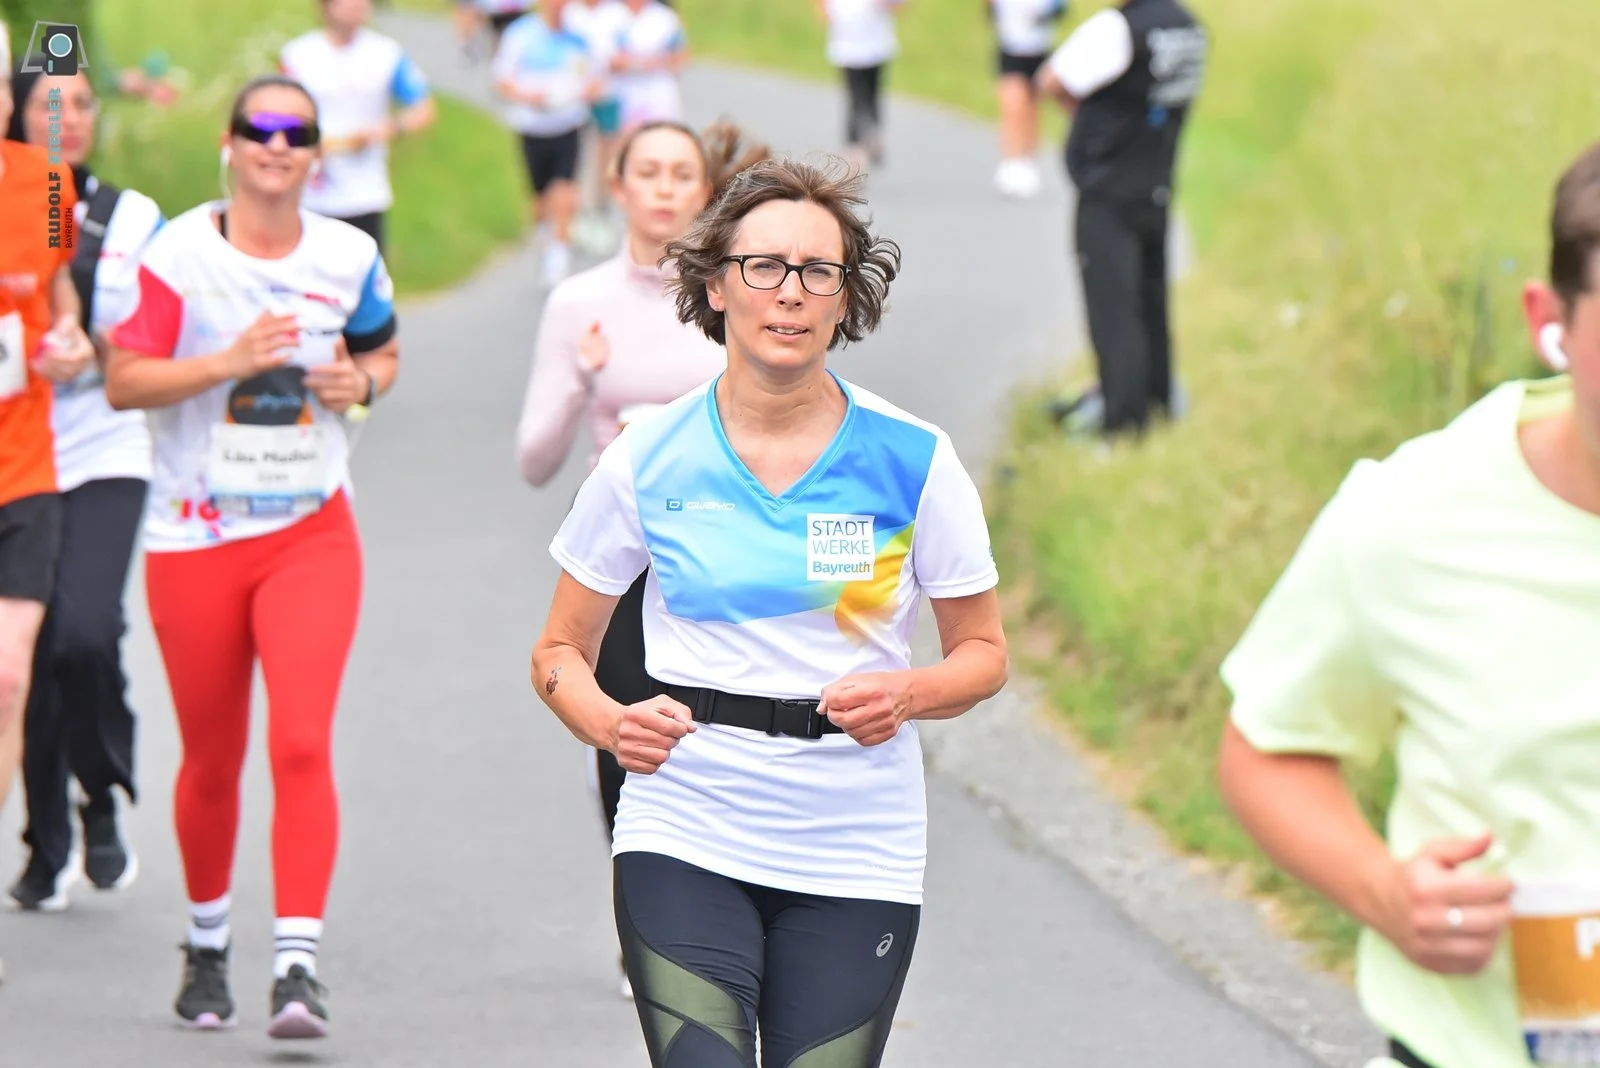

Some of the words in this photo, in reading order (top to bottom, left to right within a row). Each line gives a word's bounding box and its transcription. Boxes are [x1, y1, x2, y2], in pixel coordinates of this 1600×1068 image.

[812, 520, 869, 536] STADT
[812, 540, 871, 555] WERKE
[812, 561, 870, 576] Bayreuth
